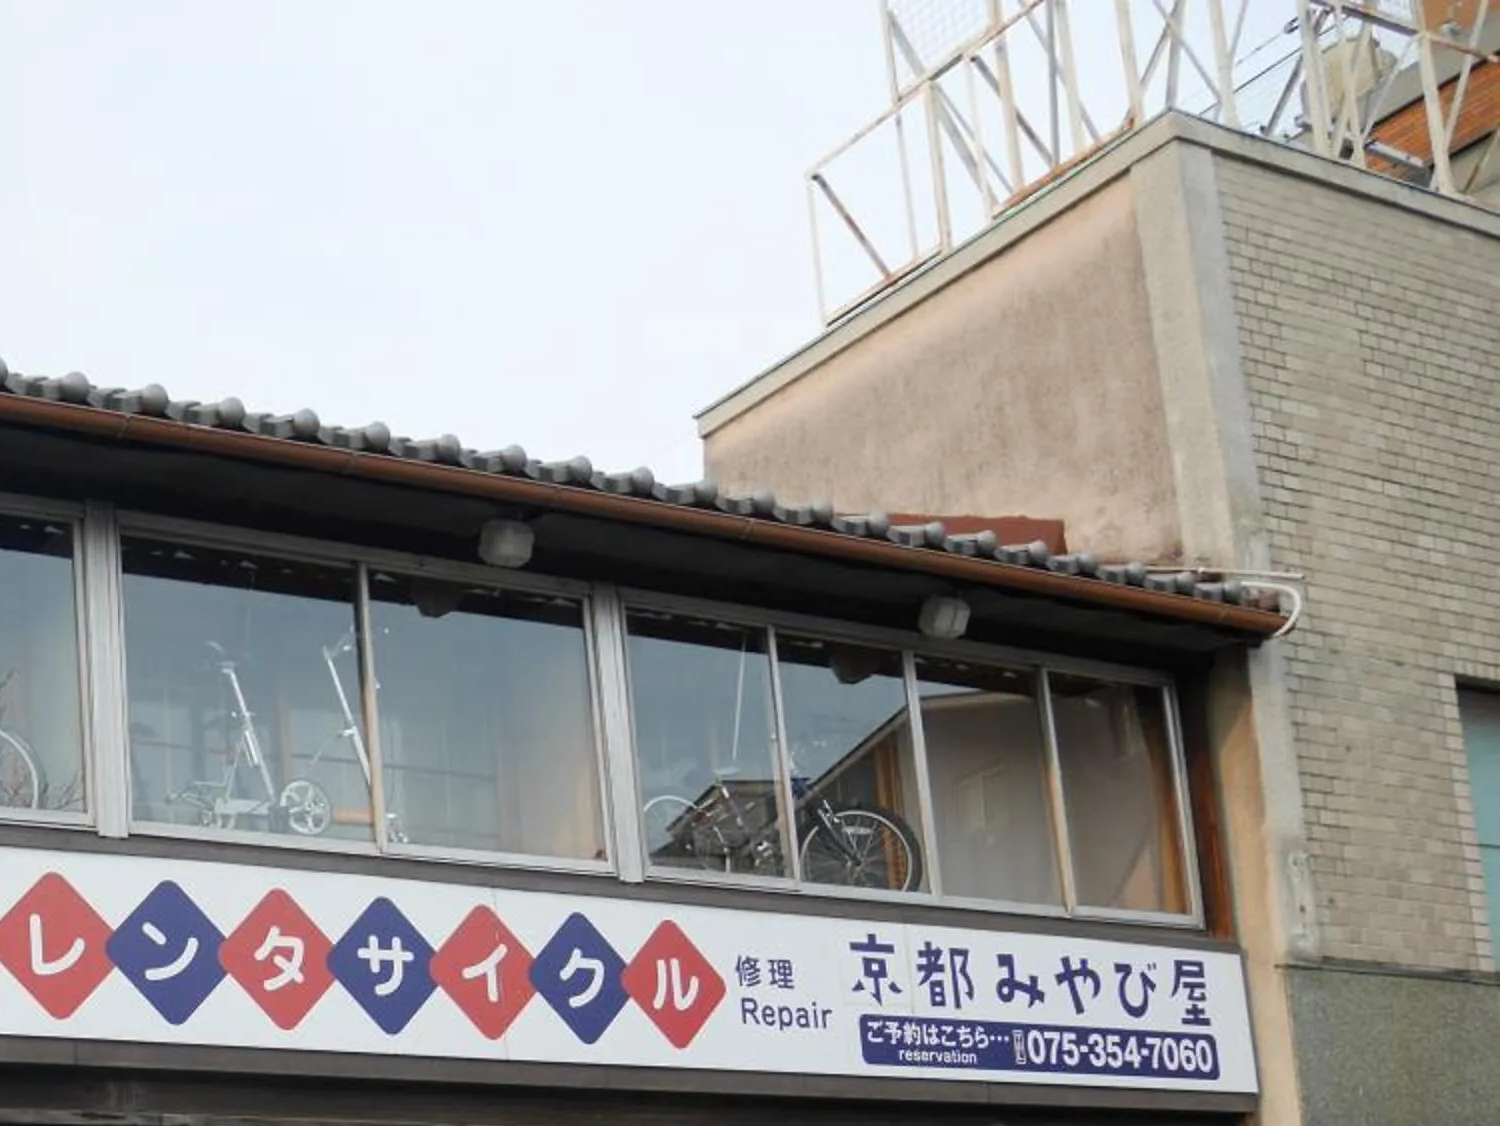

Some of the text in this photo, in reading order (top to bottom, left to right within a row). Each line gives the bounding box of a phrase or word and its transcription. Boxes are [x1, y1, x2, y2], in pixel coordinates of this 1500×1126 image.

[29, 912, 699, 1013] レンタサイクル
[734, 955, 795, 990] 修理
[848, 932, 1211, 1027] 京都みやび屋
[741, 997, 833, 1031] Repair
[898, 1049, 978, 1064] reservation
[1026, 1028, 1214, 1075] 075-354-7060
